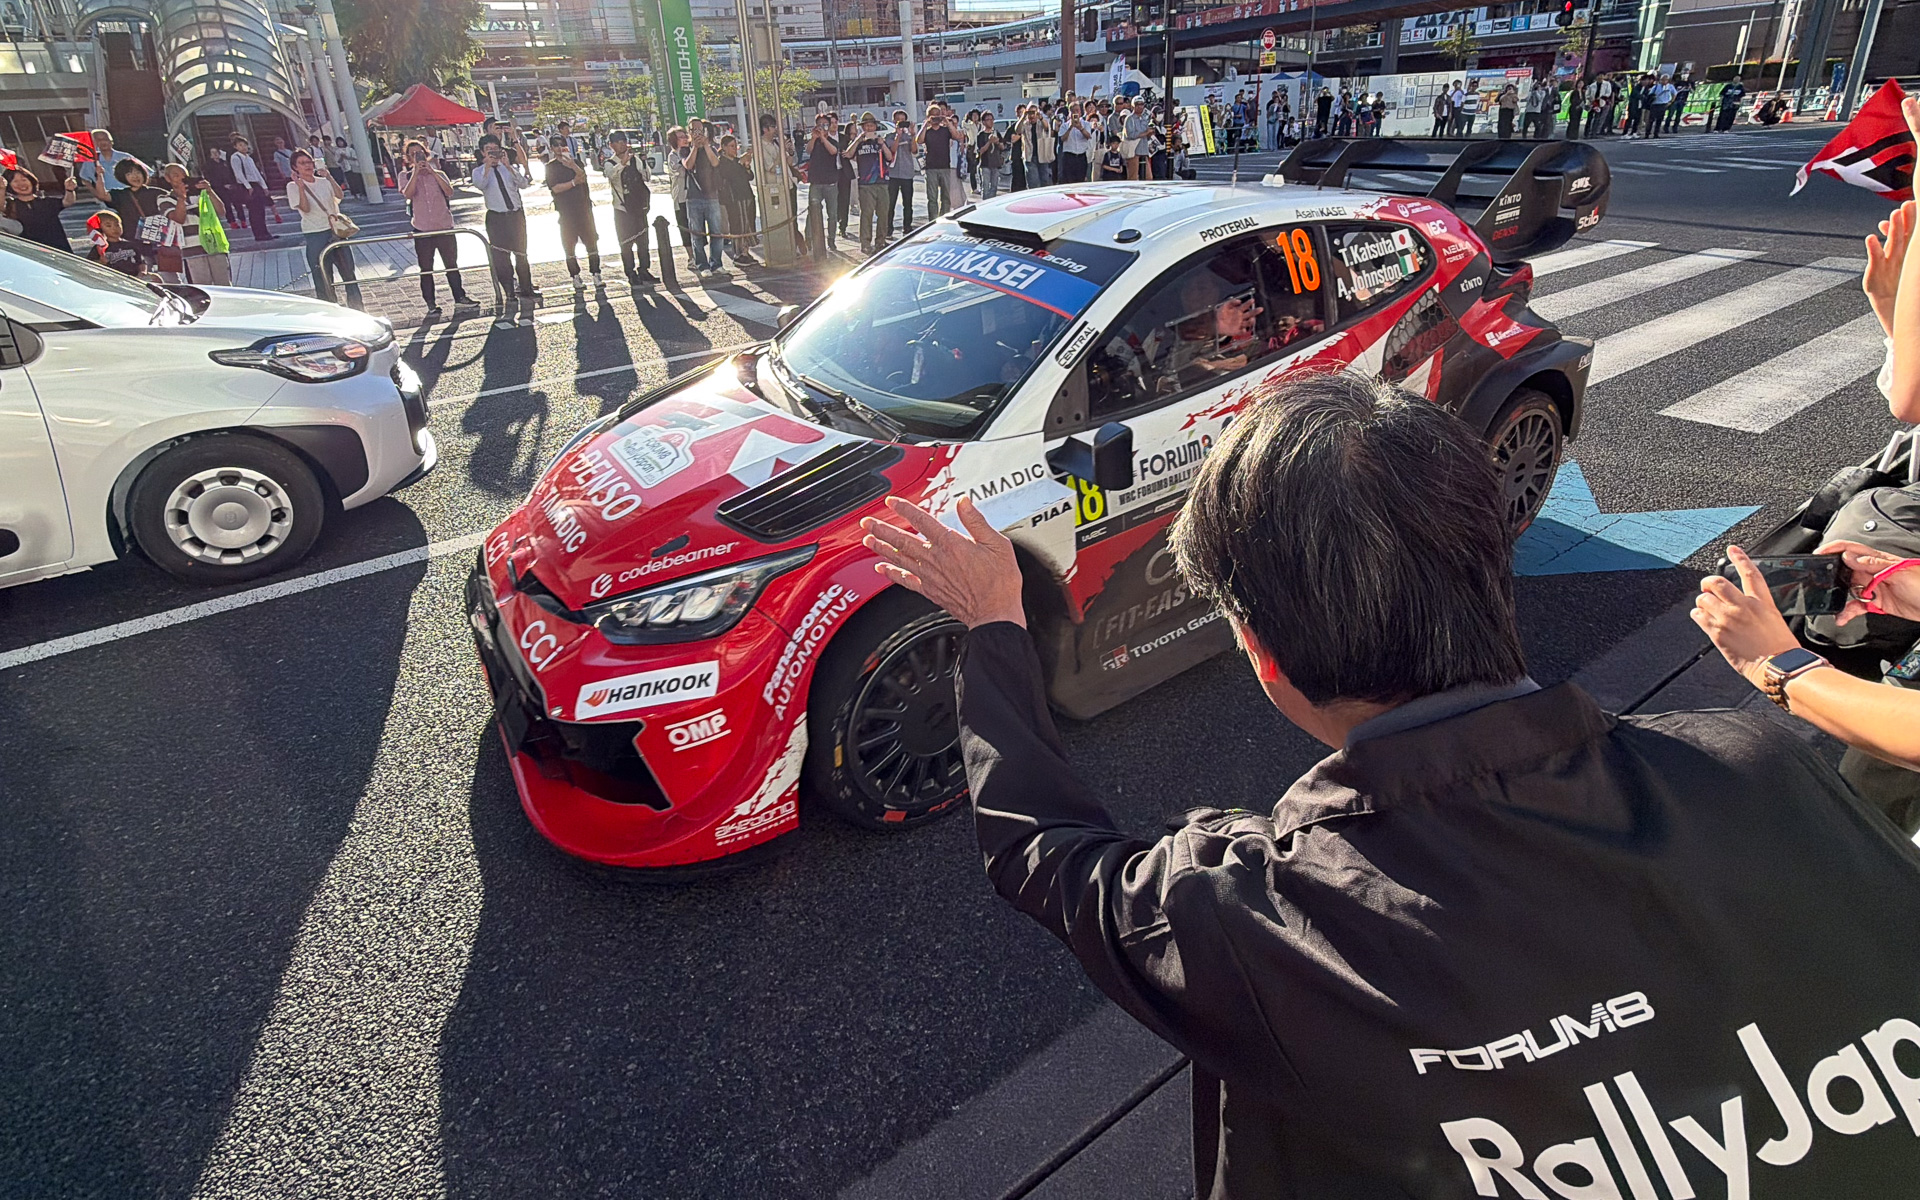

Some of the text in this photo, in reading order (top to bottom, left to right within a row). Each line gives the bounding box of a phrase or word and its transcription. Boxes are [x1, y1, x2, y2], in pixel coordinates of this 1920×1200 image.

[673, 26, 698, 121] 名古屋銀
[1199, 216, 1259, 242] PROTERIAL
[1295, 206, 1347, 219] AsahiKASEI
[903, 247, 1046, 290] AsahiKASEI
[940, 234, 1088, 273] TOYOTA GAZOO Racing
[1276, 229, 1321, 294] 18
[1338, 236, 1394, 267] T.Katsuta
[1337, 262, 1402, 298] A.Johnston
[1058, 326, 1096, 367] CENTRAL
[568, 450, 642, 521] DENSO
[953, 463, 1045, 501] TAMADIC
[1168, 470, 1192, 487] RALLY
[1031, 501, 1073, 527] PIAA
[1065, 475, 1105, 526] 18
[619, 542, 735, 583] codebeamer
[1104, 583, 1189, 642] FIT-EAS
[1130, 627, 1187, 658] TOYOTA
[1187, 608, 1225, 631] GAZO
[762, 584, 843, 706] Panasonic
[775, 589, 860, 721] AUTOMOTIVE
[668, 713, 727, 746] OMP
[1408, 990, 1655, 1075] FORUM8
